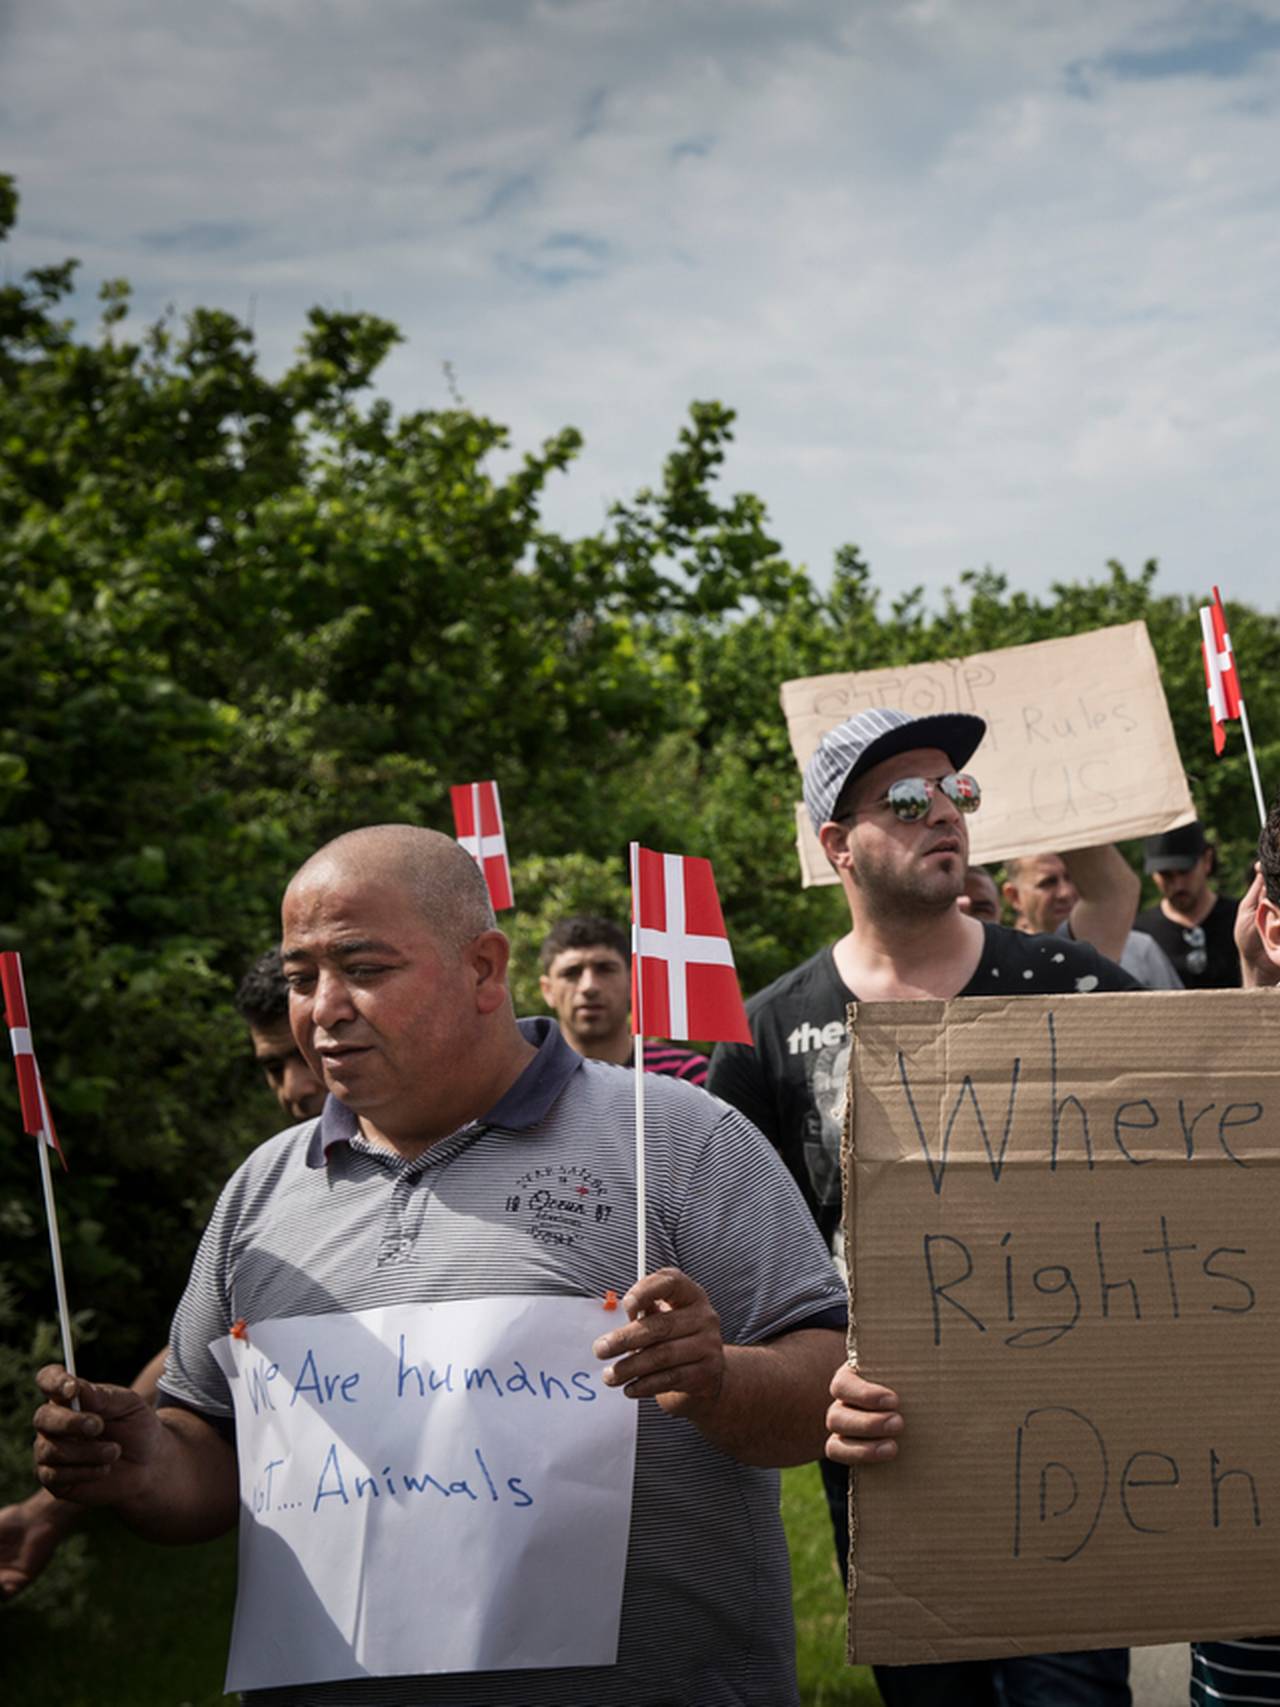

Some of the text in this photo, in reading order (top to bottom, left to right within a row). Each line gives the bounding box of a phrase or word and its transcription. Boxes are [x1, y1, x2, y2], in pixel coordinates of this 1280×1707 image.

[1021, 696, 1139, 746] Rules
[786, 1021, 845, 1055] the
[896, 1012, 1264, 1195] Where
[923, 1216, 1257, 1348] Rights
[289, 1348, 361, 1407] Are
[396, 1333, 597, 1403] humans
[312, 1443, 535, 1513] Animals
